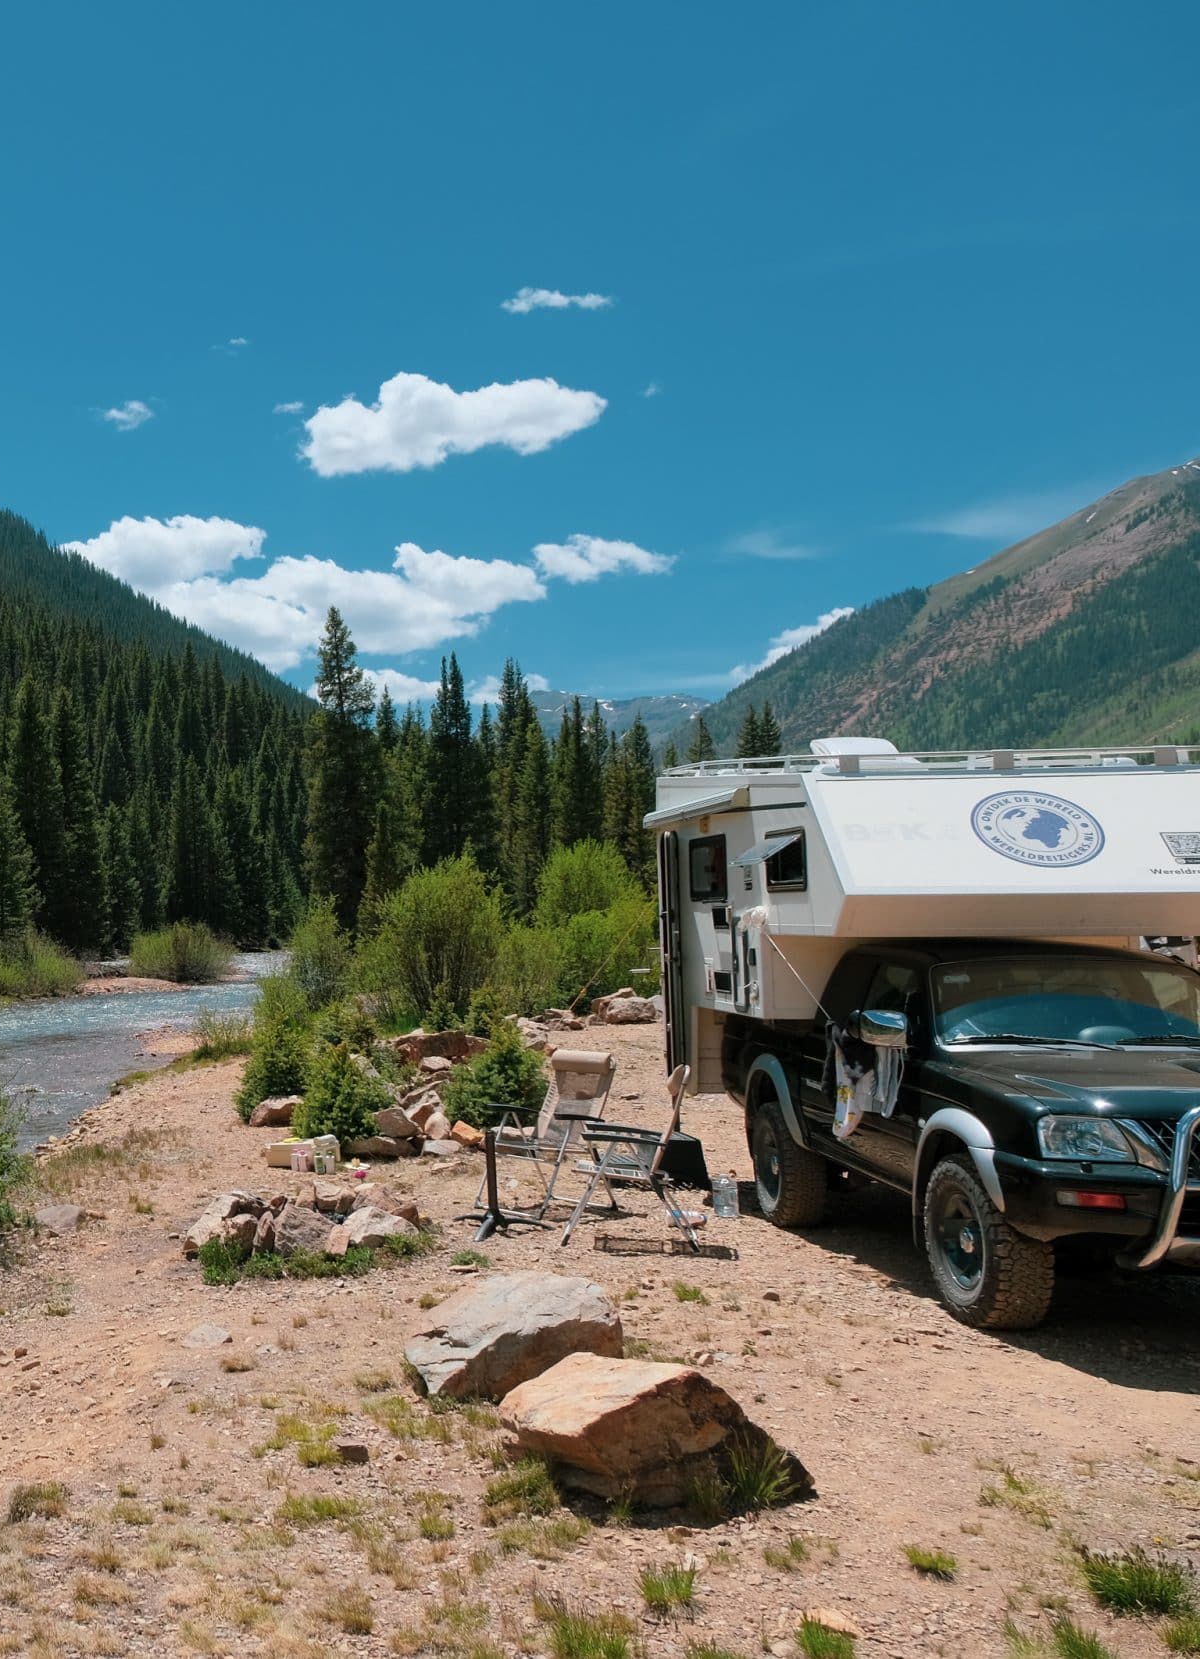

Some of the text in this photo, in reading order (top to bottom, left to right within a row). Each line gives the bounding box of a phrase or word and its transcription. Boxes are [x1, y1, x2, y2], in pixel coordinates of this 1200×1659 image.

[982, 798, 1011, 822] ONTDEK
[1035, 797, 1082, 820] WERELD
[991, 832, 1094, 862] WERELDREIZIGERS.NL
